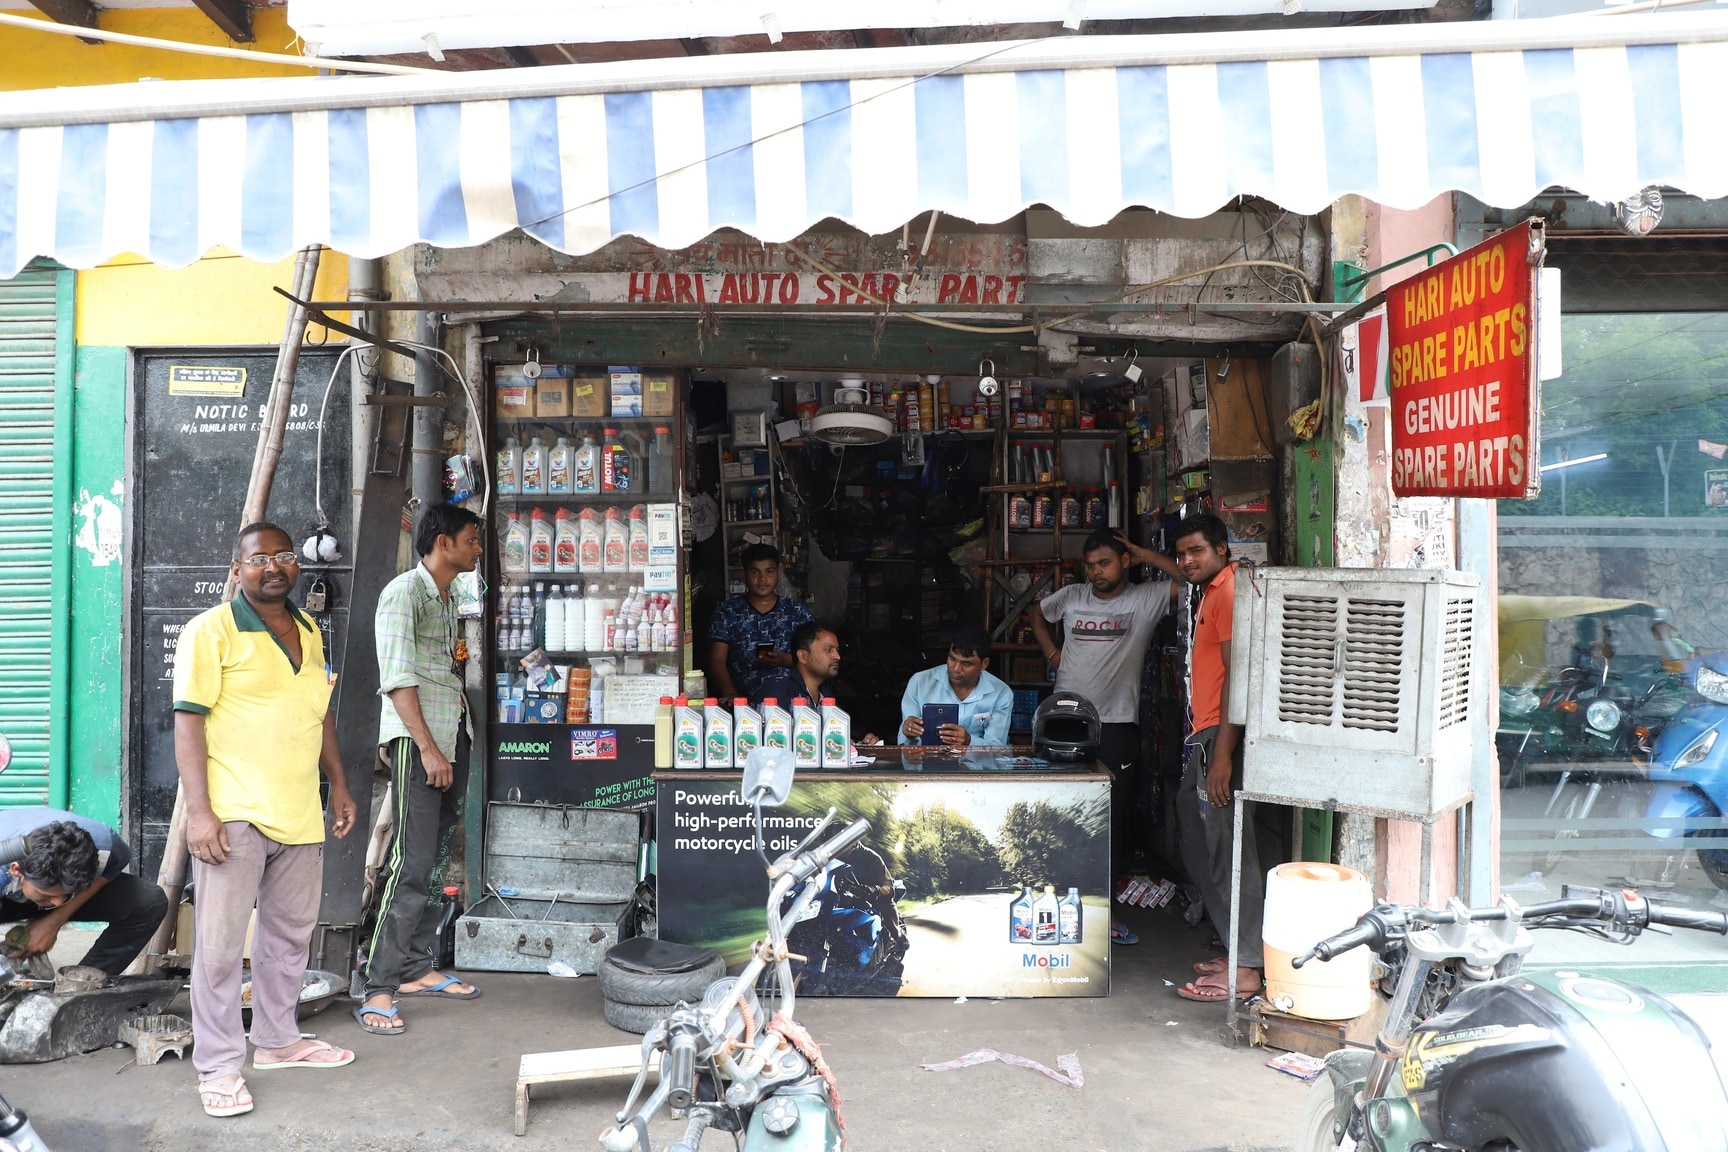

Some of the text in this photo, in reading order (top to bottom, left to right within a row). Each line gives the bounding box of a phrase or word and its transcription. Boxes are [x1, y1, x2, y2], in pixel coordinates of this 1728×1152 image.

[628, 271, 705, 304] HARI
[718, 271, 799, 304] AUTO
[937, 273, 1026, 304] PART
[1404, 243, 1505, 328] HARI AUTO
[1392, 302, 1527, 388] SPARE PARTS
[259, 403, 308, 418] BRD
[1405, 381, 1501, 435] GENUINE
[200, 423, 226, 432] URMILA
[228, 423, 247, 432] DEVI
[603, 452, 613, 485] MOTUL
[1395, 434, 1524, 488] SPARE PARTS
[1075, 620, 1124, 631] ROCK
[499, 741, 549, 753] AMARON
[580, 786, 655, 808] SSURANCE OF LONG
[595, 776, 655, 797] POWER WITH THE
[675, 790, 753, 808] Powerfu,
[675, 835, 798, 854] motorcycle oils
[1022, 953, 1070, 967] Mobil
